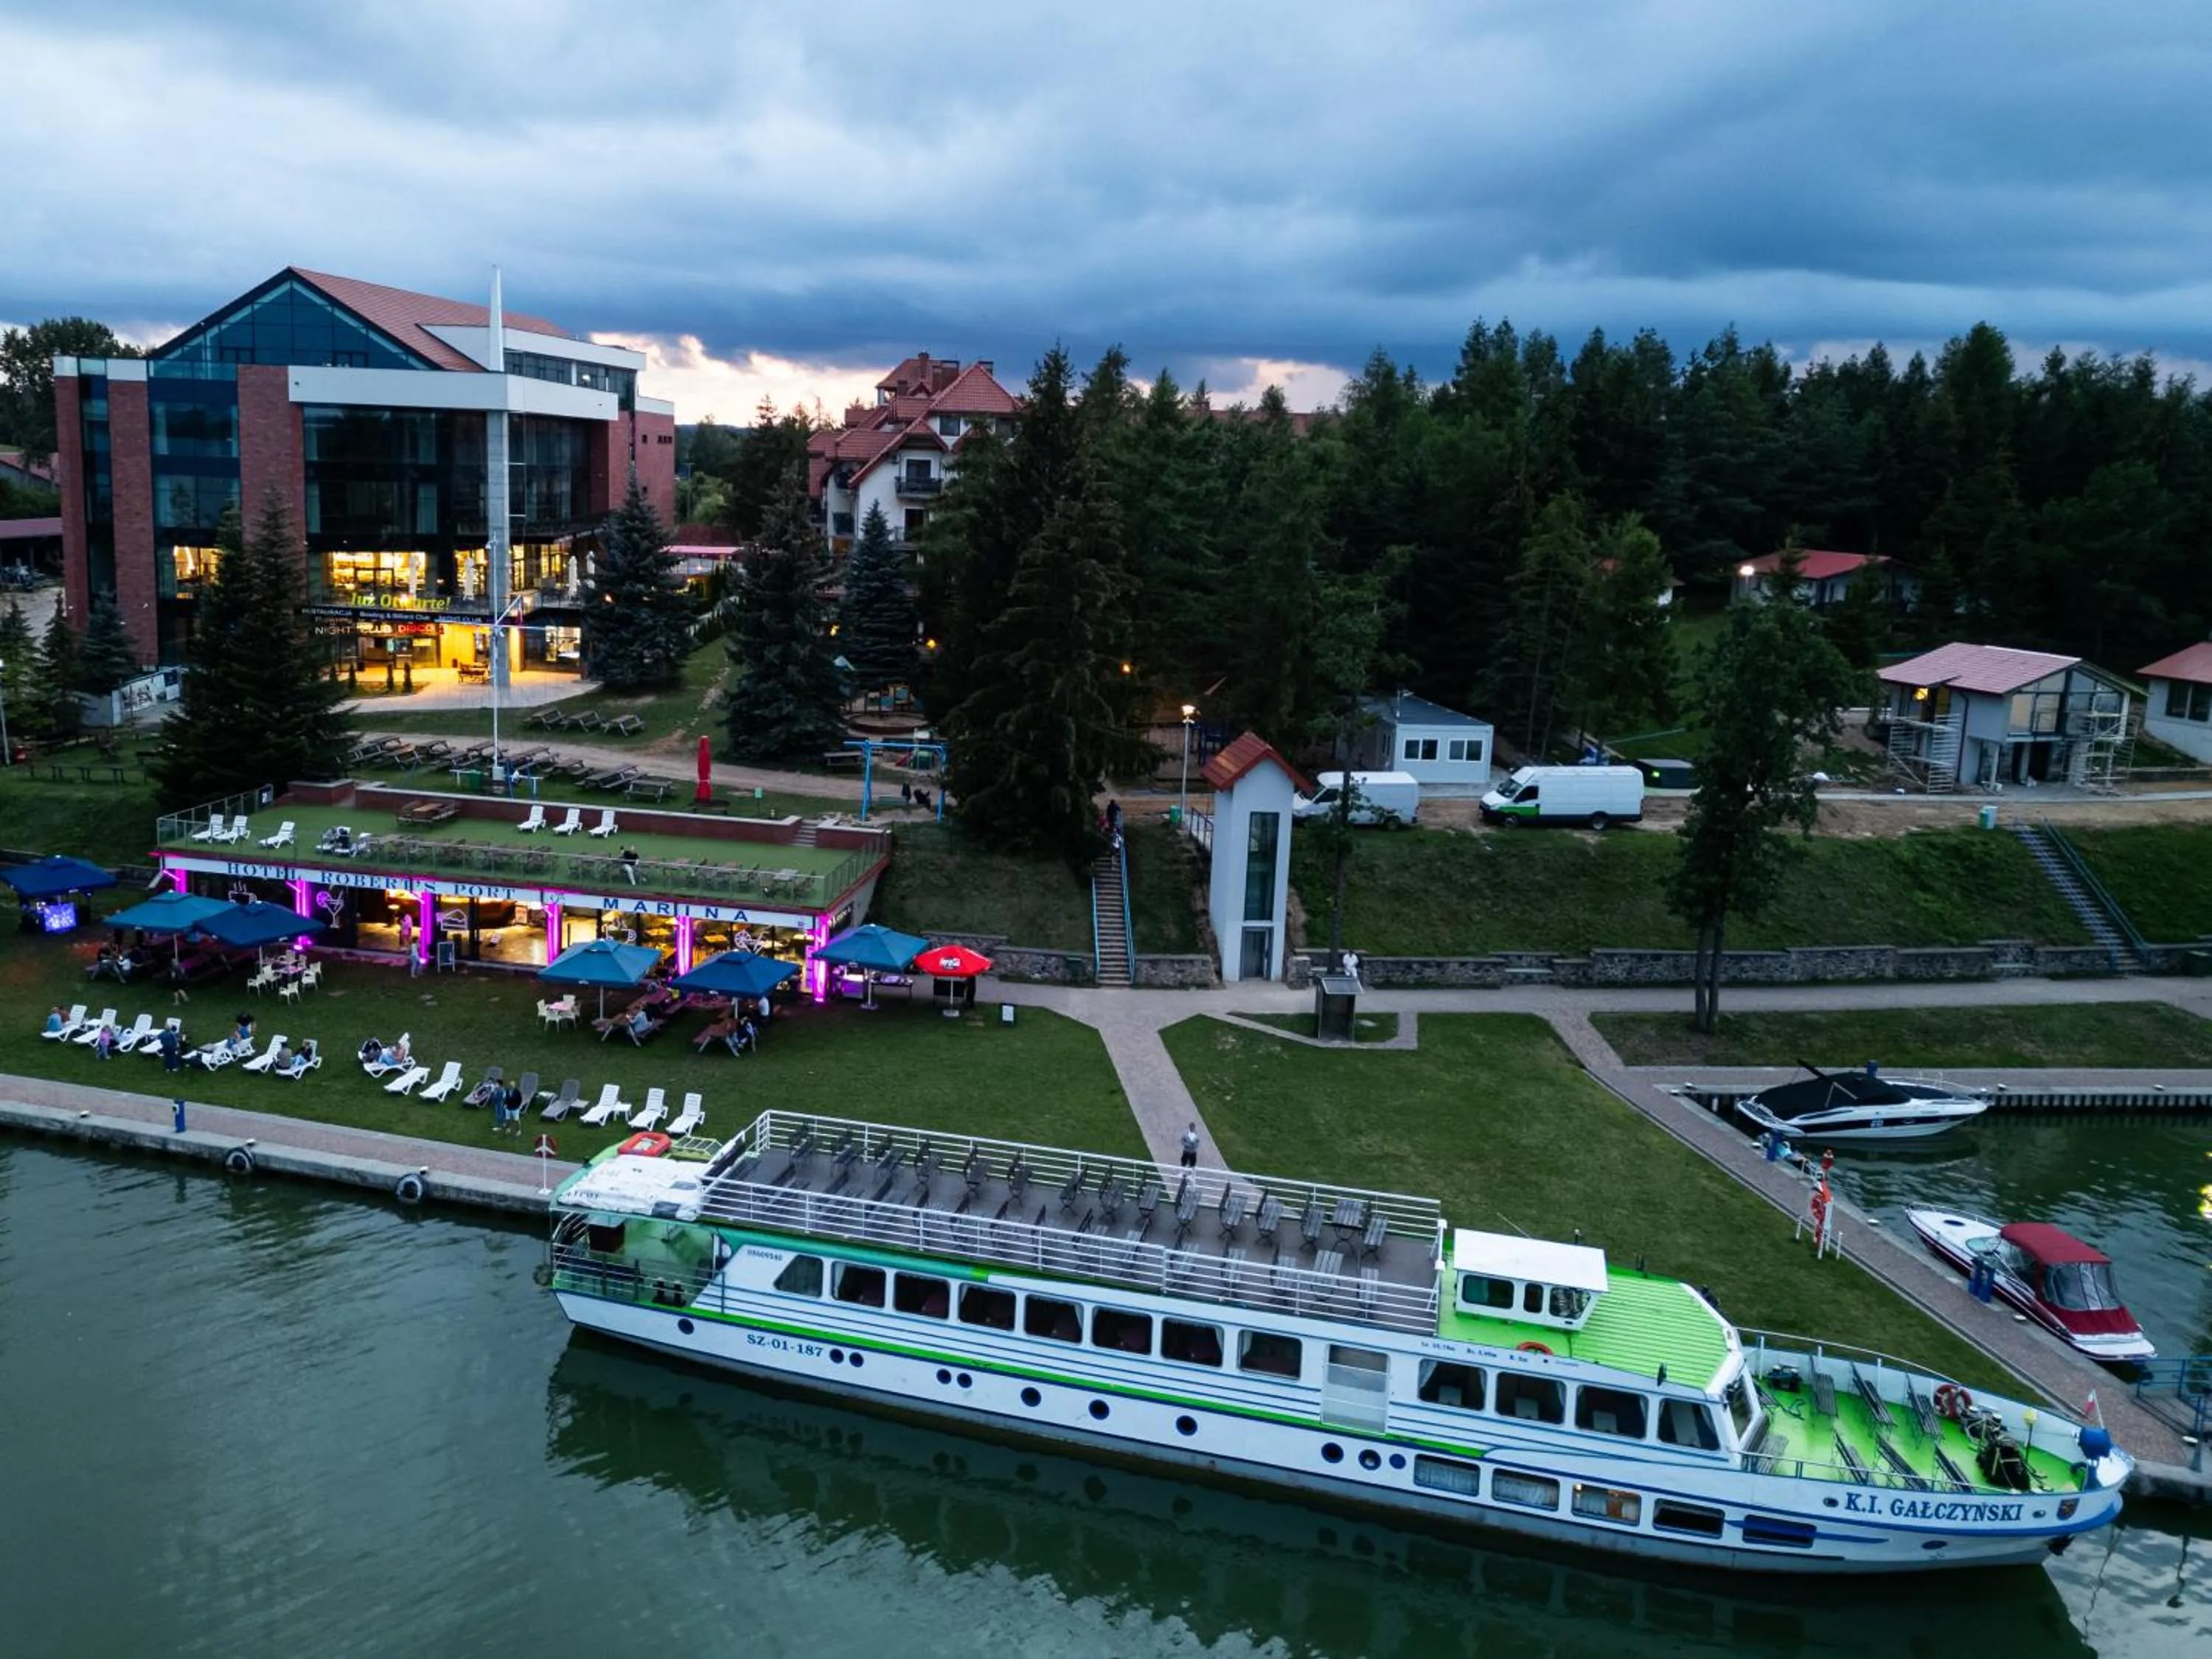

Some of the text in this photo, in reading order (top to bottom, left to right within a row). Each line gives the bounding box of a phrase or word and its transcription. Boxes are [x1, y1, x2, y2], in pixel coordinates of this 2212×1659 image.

[314, 627, 352, 636] NIGHT
[397, 624, 436, 633] DISCO
[227, 863, 748, 922] HOTEL ROBERT'S PORT MARINA
[746, 1334, 824, 1357] SZ-01-187
[1844, 1492, 2024, 1522] K.I. GAŁCZYŃSKI
